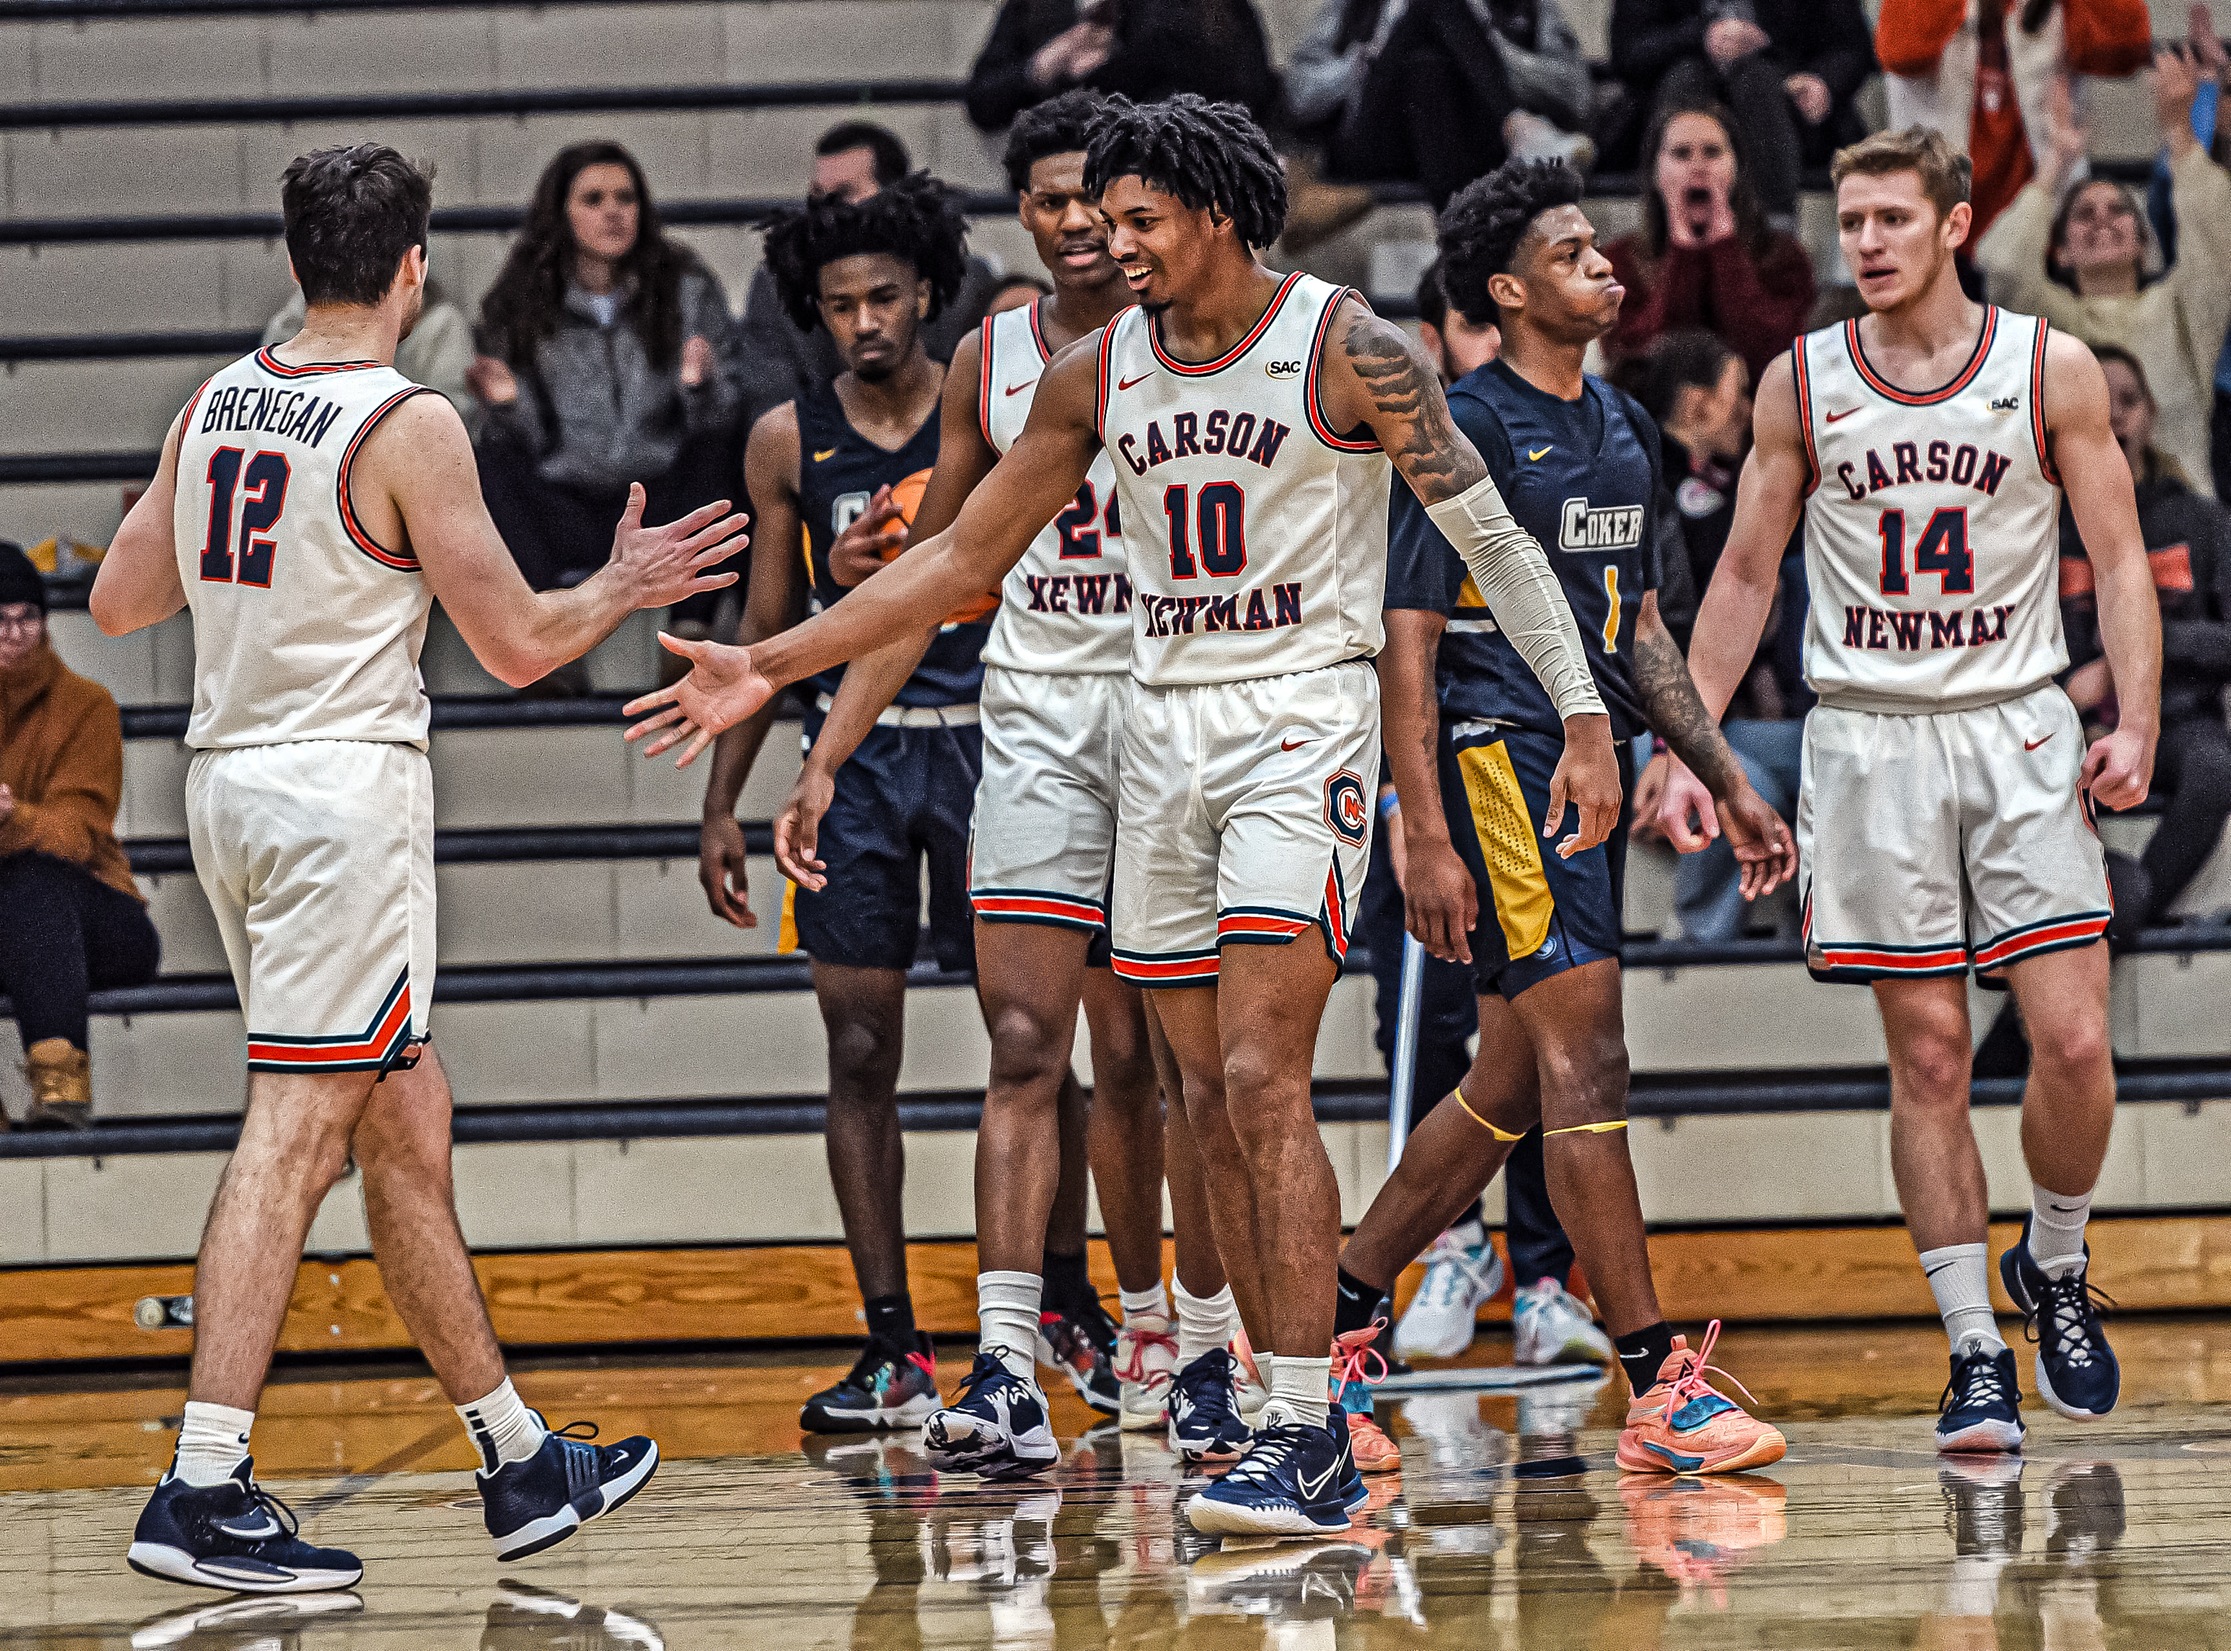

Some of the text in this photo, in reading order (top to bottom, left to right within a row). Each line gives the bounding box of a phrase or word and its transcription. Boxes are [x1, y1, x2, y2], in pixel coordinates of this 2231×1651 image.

[1270, 360, 1302, 375] SAC
[201, 386, 343, 449] BRENEGAN
[1118, 410, 1291, 476] CARSON
[1837, 440, 2013, 500] CARSON
[200, 445, 291, 589] 12
[1163, 480, 1248, 581] 10
[1560, 498, 1644, 551] COKER
[1879, 506, 1975, 596] 14
[1140, 582, 1303, 638] NEWMAN
[1603, 565, 1621, 653] 1
[1842, 604, 2017, 651] NEWMAN
